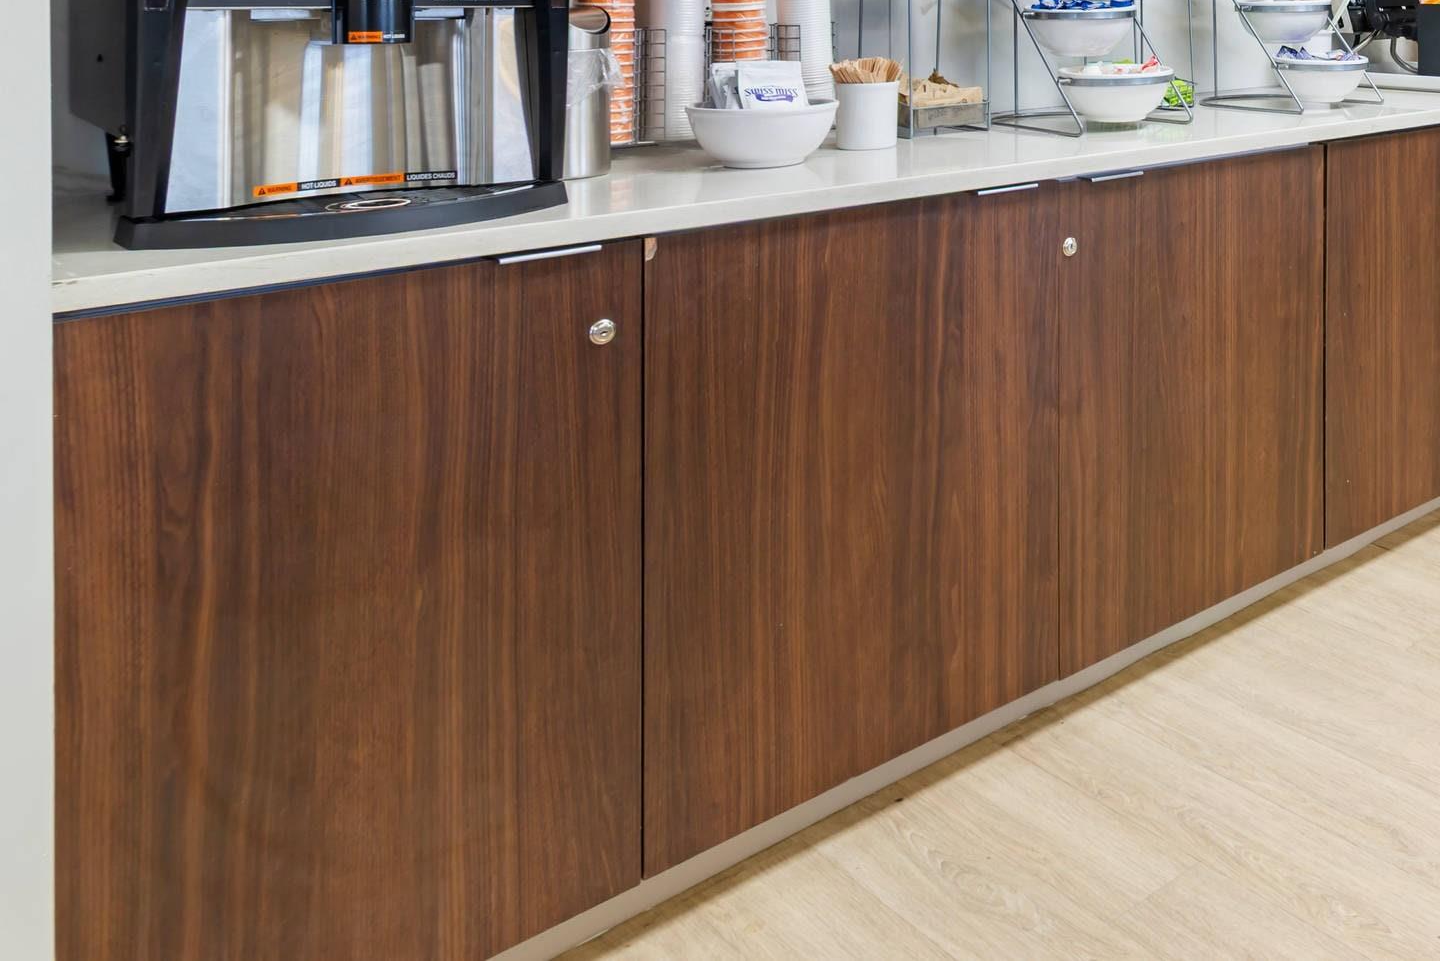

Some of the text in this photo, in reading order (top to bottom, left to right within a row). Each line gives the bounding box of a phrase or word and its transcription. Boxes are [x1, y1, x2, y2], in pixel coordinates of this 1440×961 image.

[406, 172, 456, 181] LIQUIDES CHAUDS
[314, 180, 337, 189] LIQUIDS
